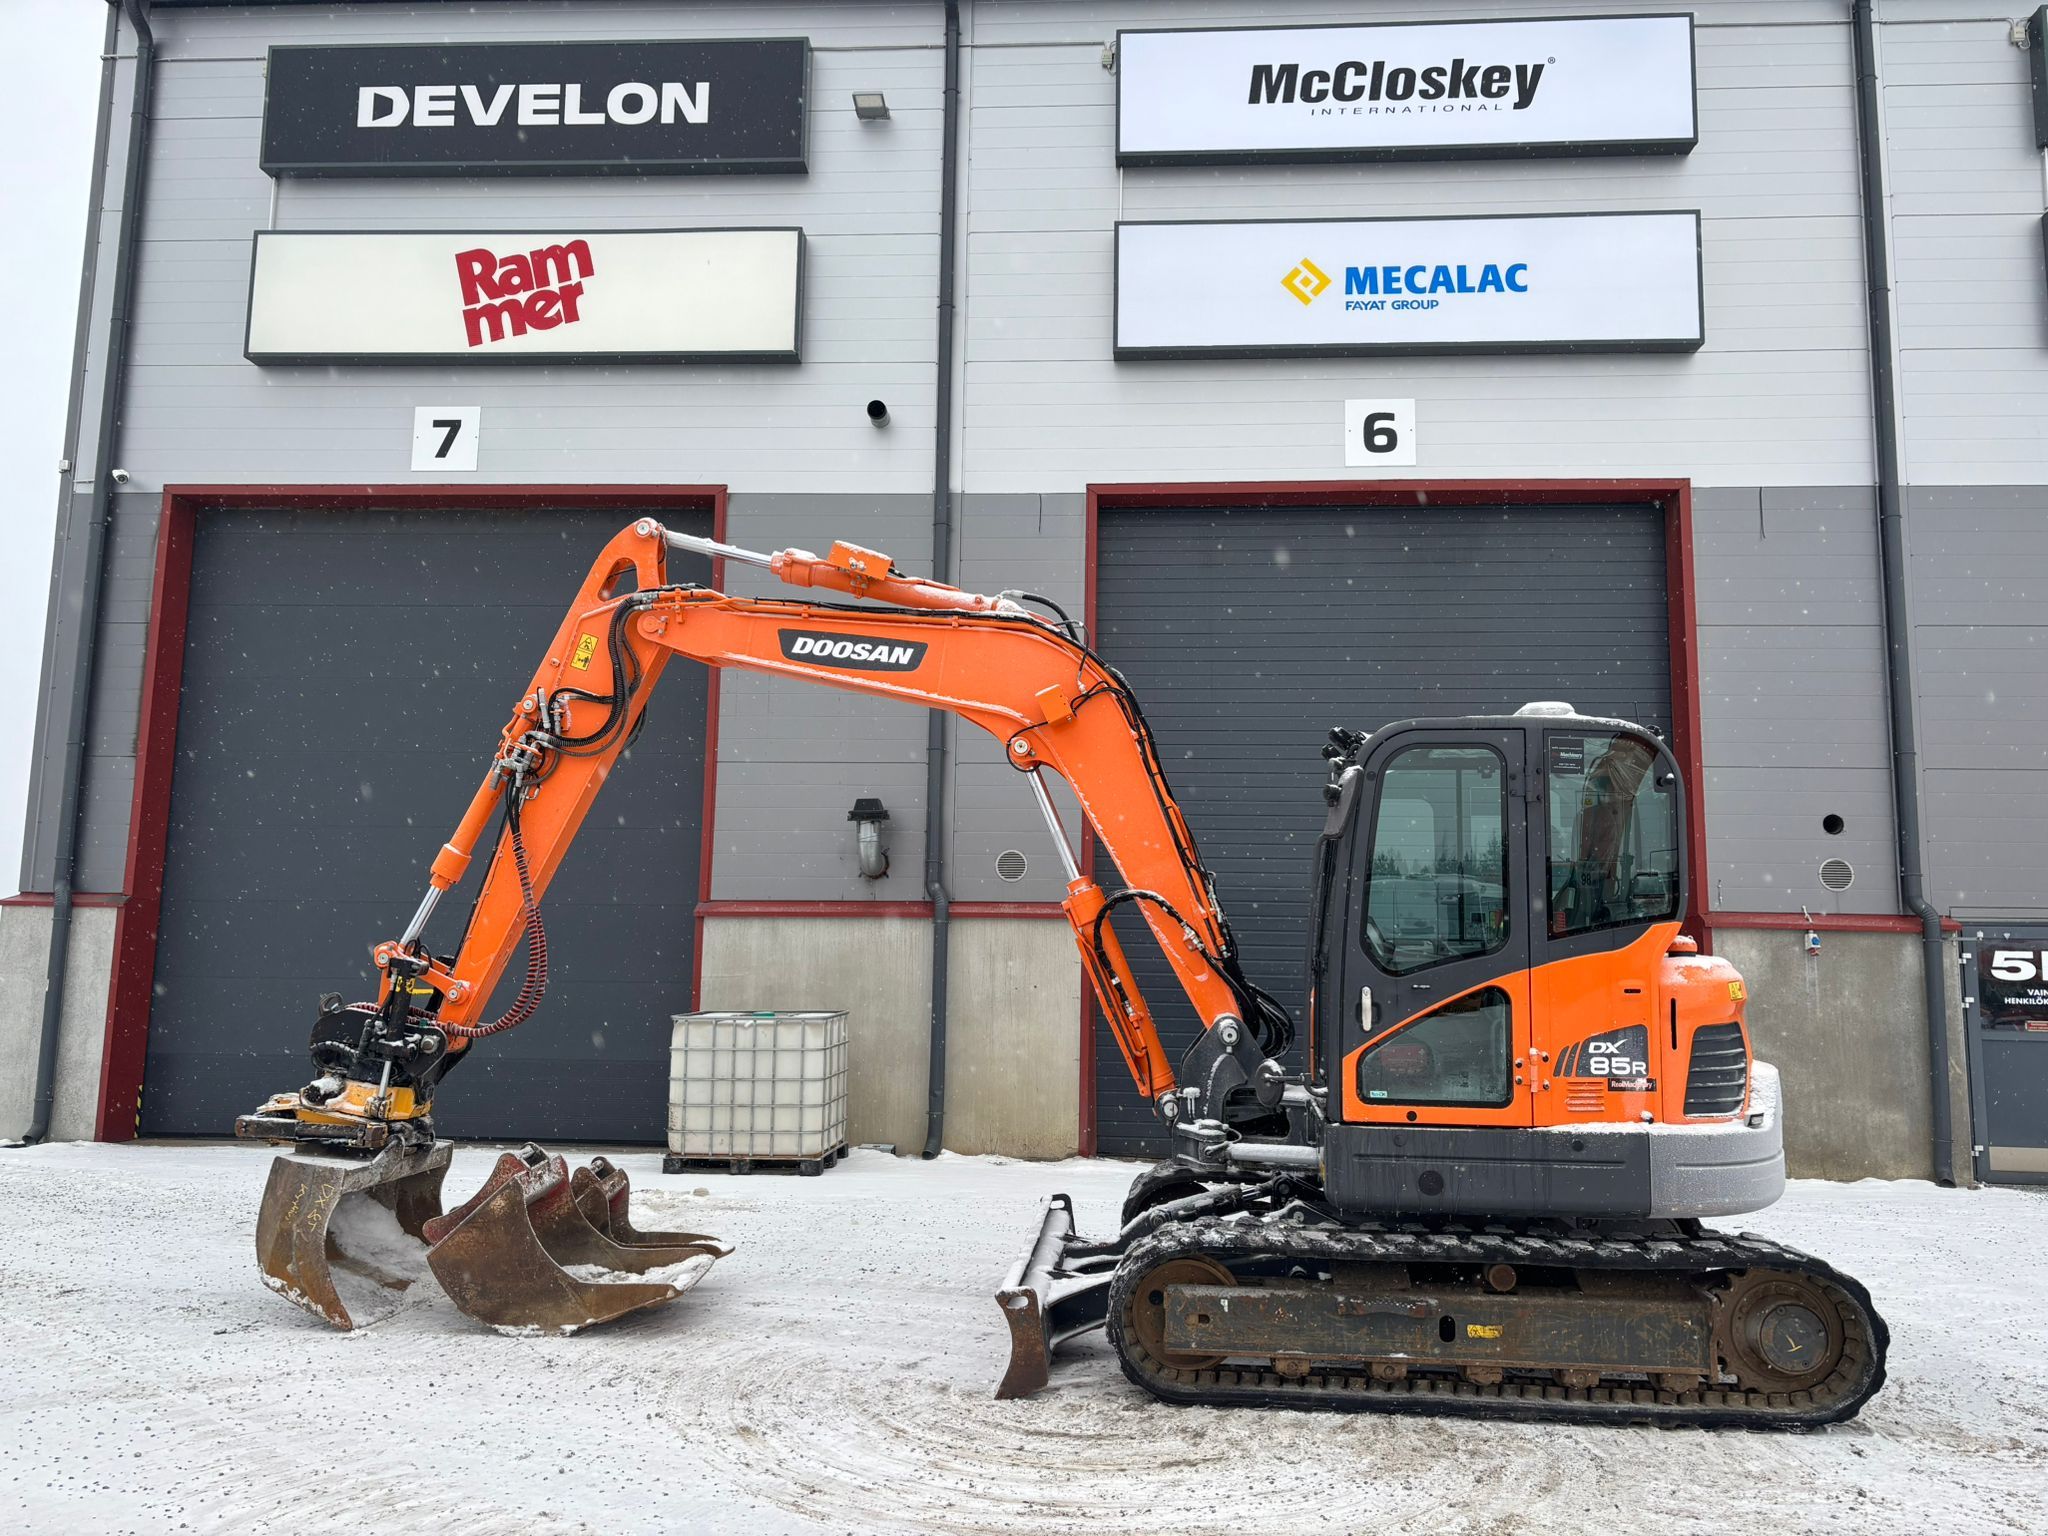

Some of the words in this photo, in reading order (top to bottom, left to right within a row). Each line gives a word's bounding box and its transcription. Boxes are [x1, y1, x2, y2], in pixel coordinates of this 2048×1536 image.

[1248, 58, 1545, 110] McCloskey
[357, 81, 710, 128] DEVELON
[1310, 103, 1504, 117] INTERNATIONAL
[455, 239, 595, 305] Ram
[1345, 263, 1528, 295] MECALAC
[462, 281, 585, 347] mer
[1345, 300, 1387, 312] FAYAT
[1391, 299, 1440, 311] GROUP
[432, 418, 462, 459] 7
[1362, 412, 1398, 455] 6
[791, 637, 914, 665] DOOSAN
[1991, 950, 2048, 981] 5
[1588, 1038, 1628, 1054] DX
[1590, 1057, 1647, 1075] 85R
[1611, 1080, 1653, 1090] RealMacry
